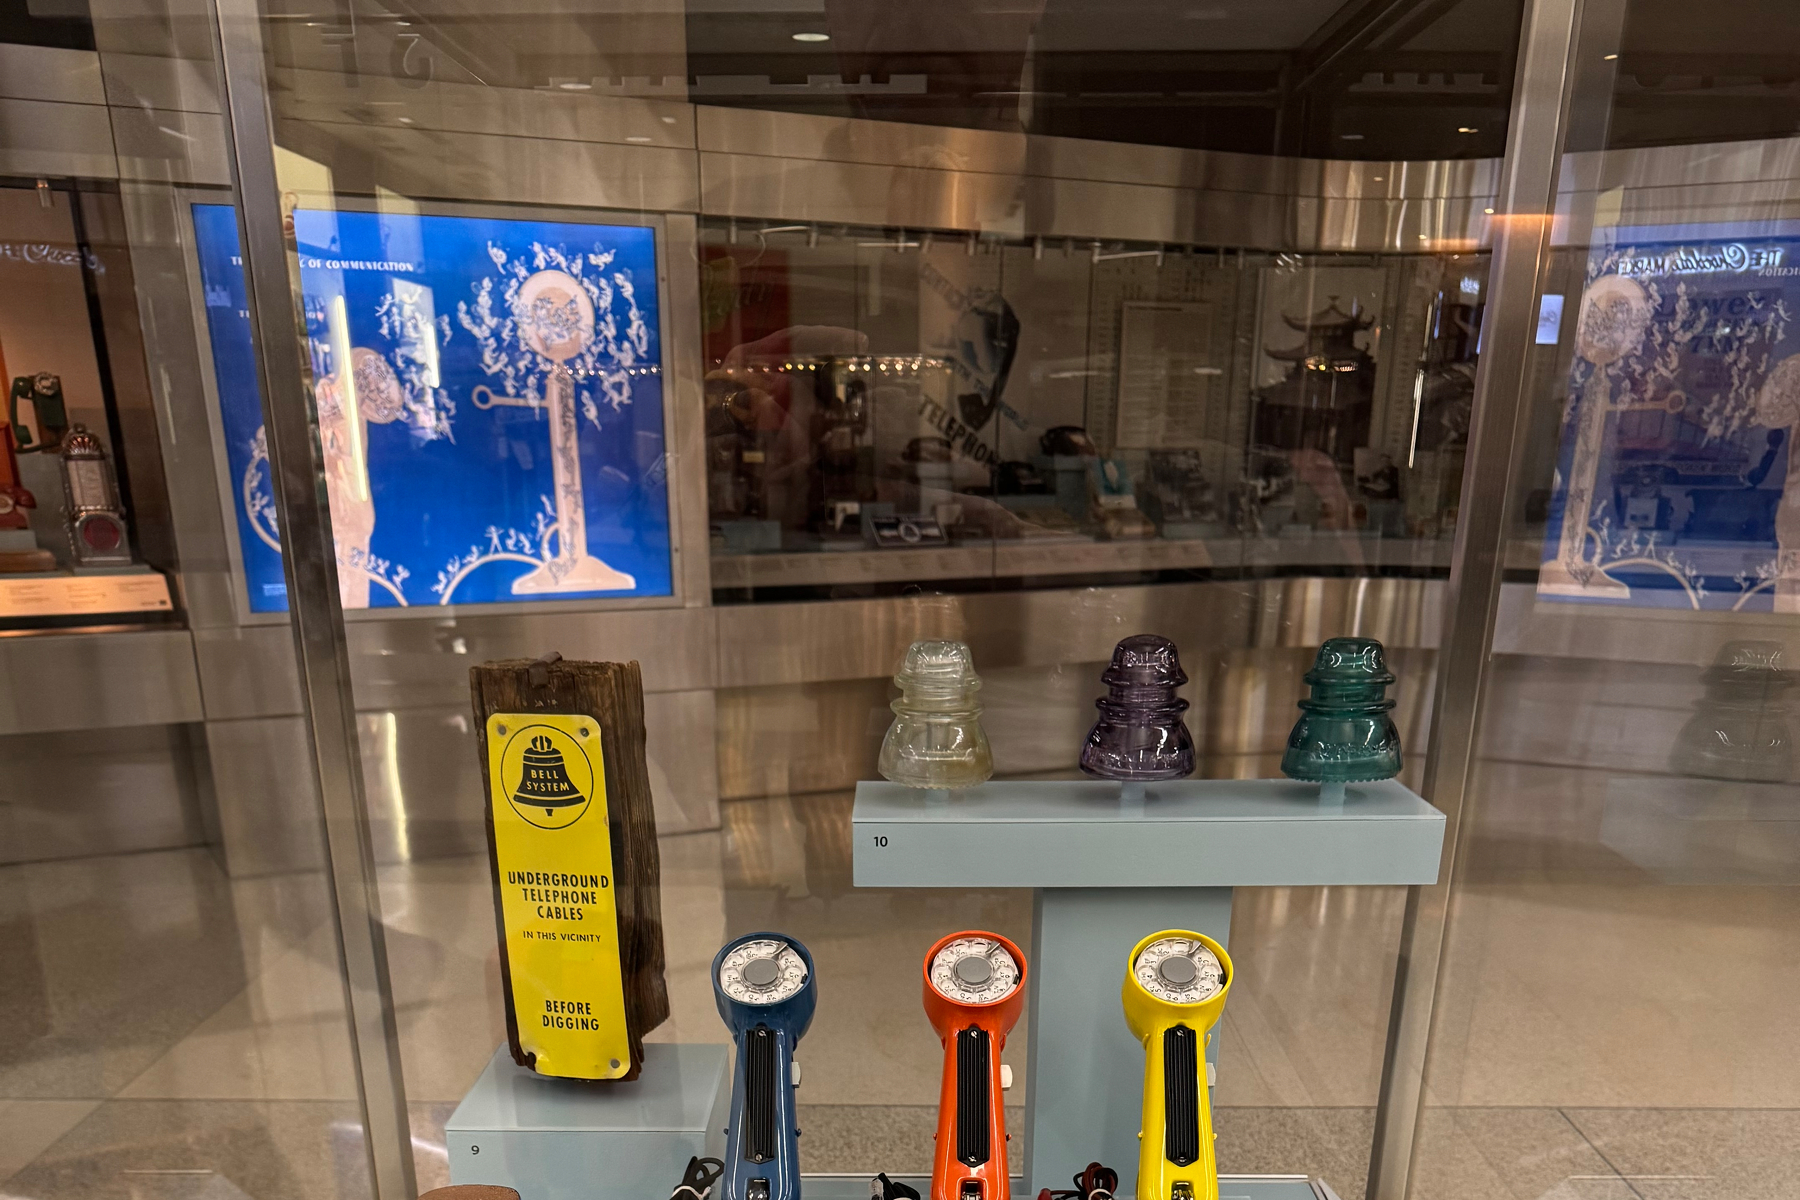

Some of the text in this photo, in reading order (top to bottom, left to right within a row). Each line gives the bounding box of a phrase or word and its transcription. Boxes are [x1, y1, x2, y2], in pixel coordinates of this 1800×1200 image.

[308, 260, 320, 268] OF
[326, 260, 414, 272] COMMUNICATION
[531, 770, 559, 780] BELL
[526, 780, 570, 792] SYSTEM
[873, 836, 888, 848] 10
[508, 870, 610, 888] UNDERGROUND
[522, 888, 598, 904] TELEPHONE
[536, 906, 584, 920] CABLES
[522, 930, 601, 942] IN THIS VICINITY
[546, 1000, 592, 1016] BEFORE
[542, 1014, 600, 1031] DIGGING
[471, 1145, 480, 1155] 9
